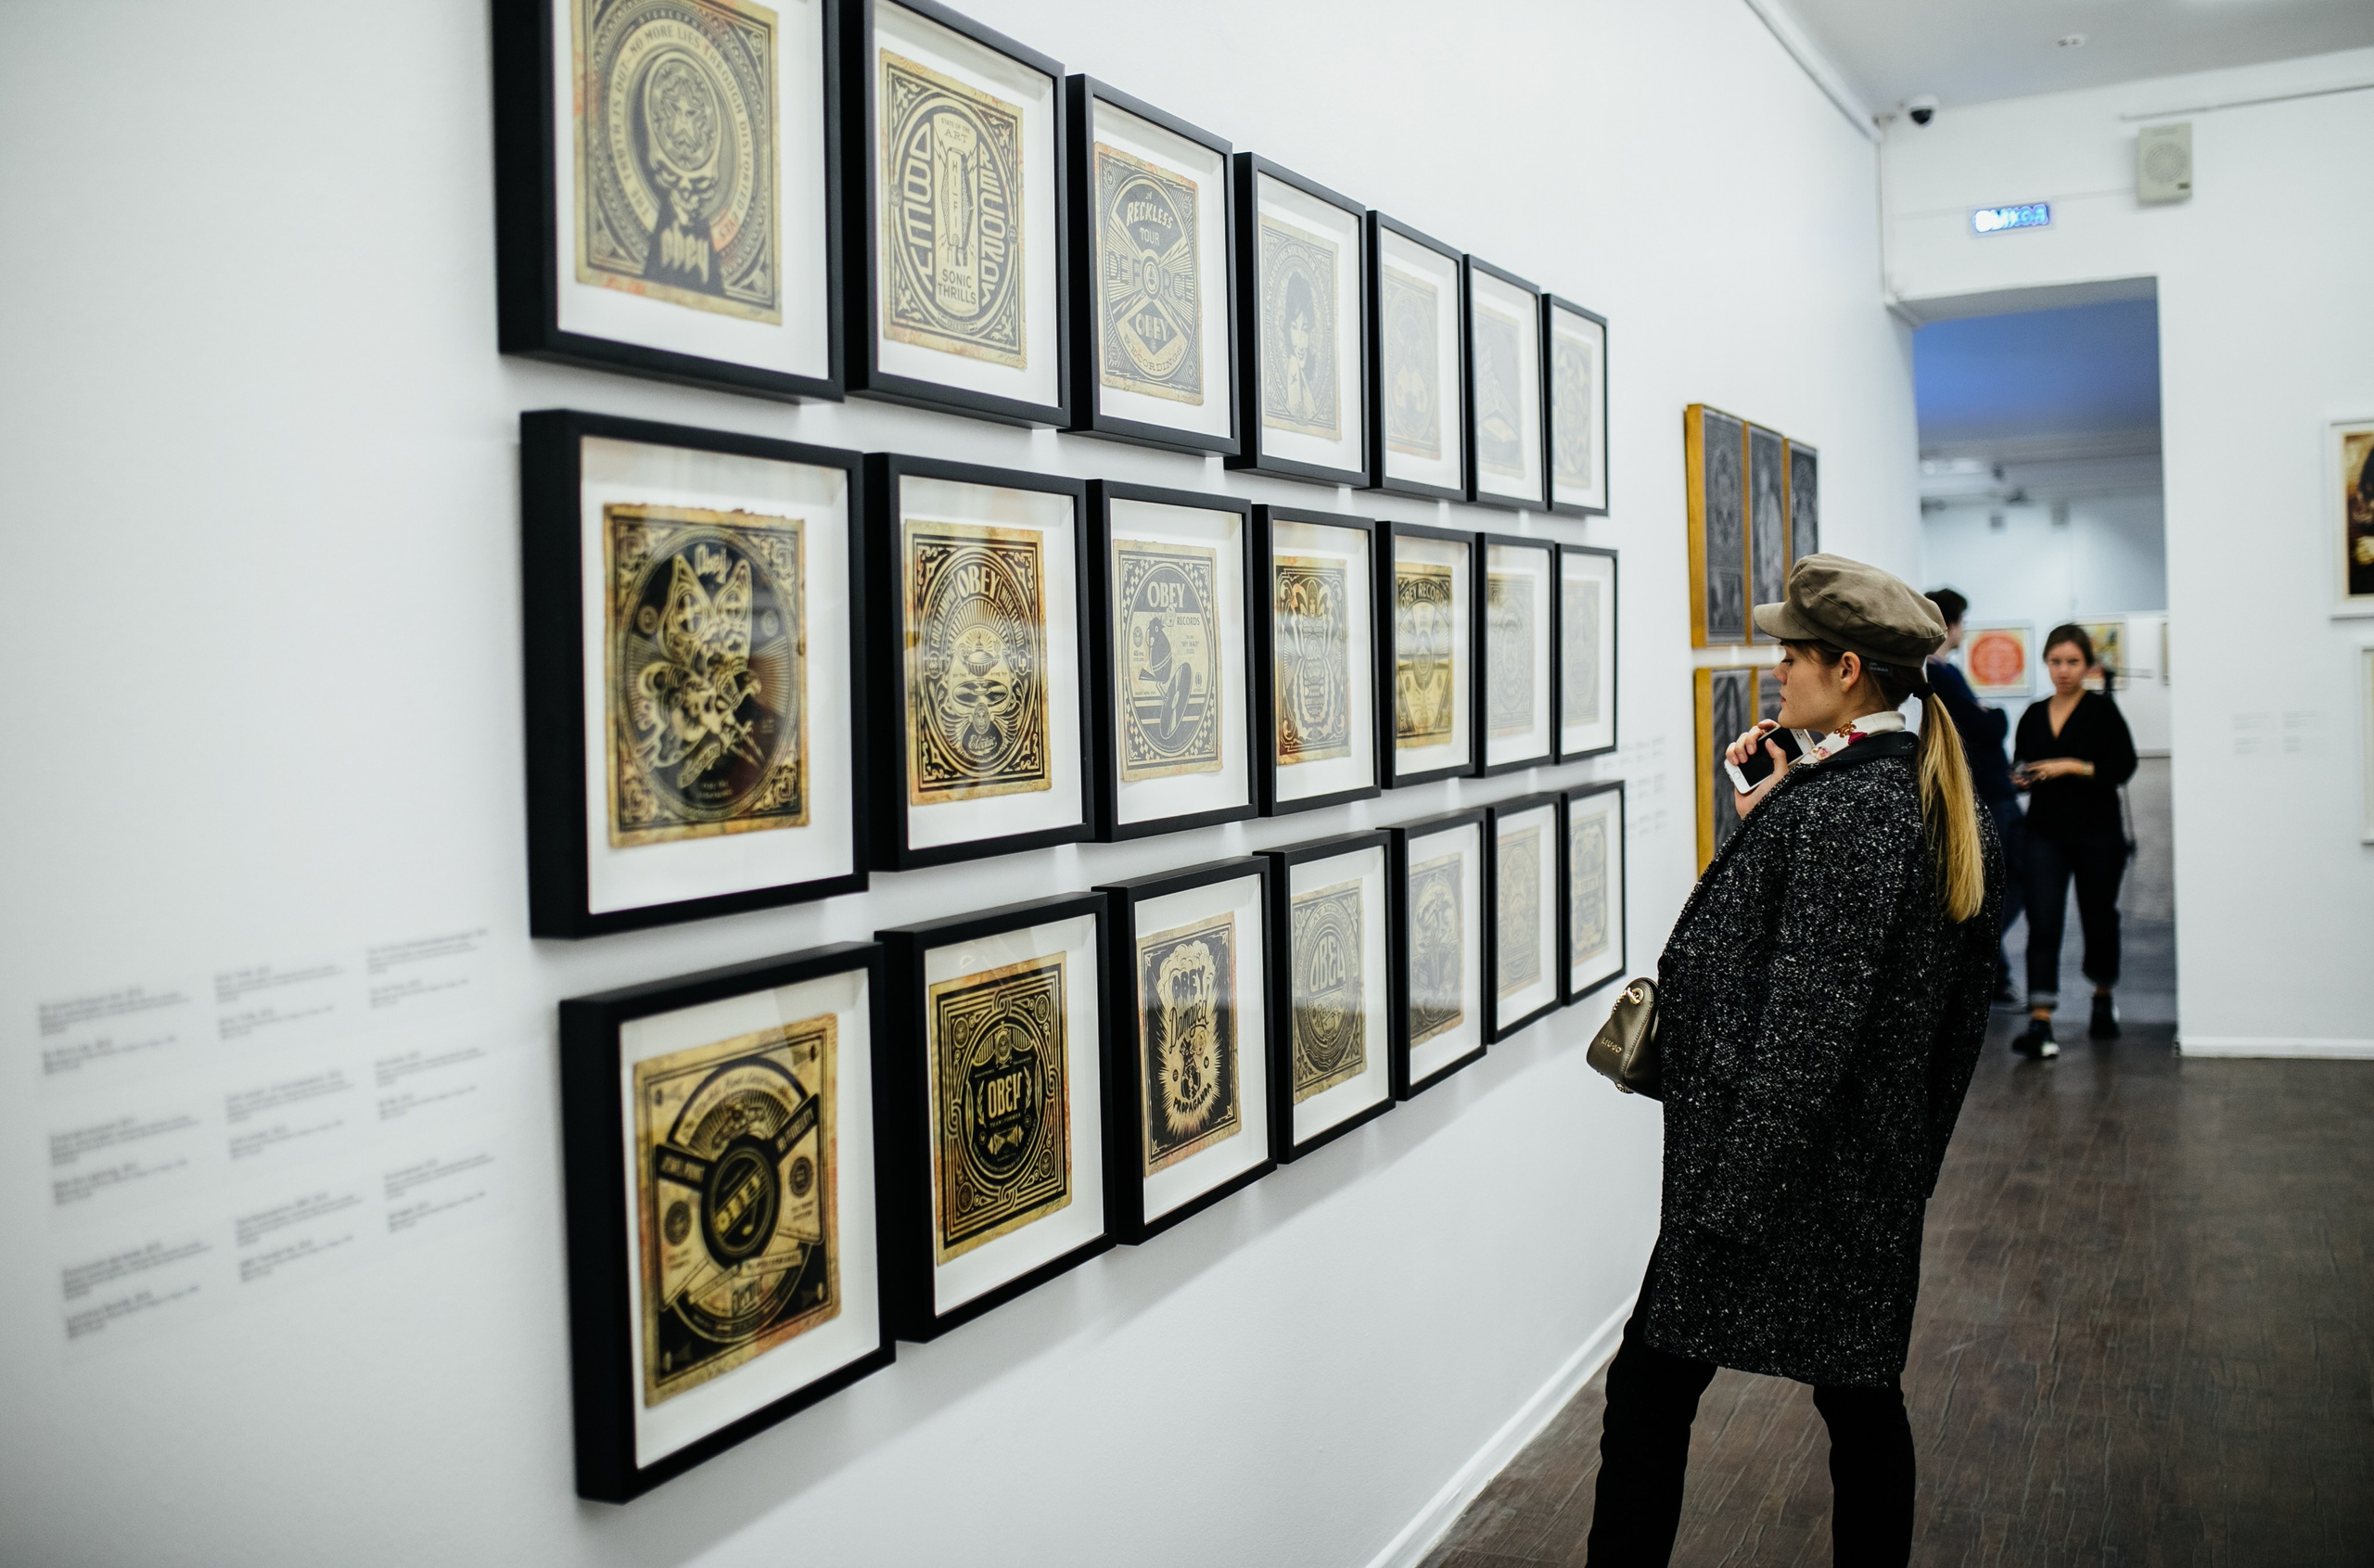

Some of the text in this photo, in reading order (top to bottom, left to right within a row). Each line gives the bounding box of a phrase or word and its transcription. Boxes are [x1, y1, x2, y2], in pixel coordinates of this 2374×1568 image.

[615, 63, 630, 92] OUT
[630, 36, 645, 55] NO
[645, 24, 674, 41] MORE
[677, 26, 700, 47] LIES
[703, 45, 744, 114] THROUGH
[736, 122, 752, 210] DISTORTED
[941, 117, 955, 127] STATE
[944, 129, 968, 144] ART
[1126, 200, 1174, 229] RECKLESS
[1140, 226, 1160, 246] TOUR
[942, 268, 972, 288] SONIC
[938, 282, 976, 305] THRILLS
[1135, 312, 1169, 341] OBEY
[1124, 334, 1182, 372] RECORDINGS
[957, 565, 1001, 600] OBEY
[1147, 580, 1185, 608] OBEY
[1000, 586, 1015, 611] WITH
[1401, 582, 1449, 614] OBEY RECORDS
[931, 618, 944, 648] COLD
[1176, 617, 1200, 625] RECORDS
[1309, 935, 1347, 993] OBEY
[1172, 965, 1206, 1000] OBEY
[1168, 984, 1209, 1055] Damaged
[988, 1071, 1023, 1119] OBEY
[1173, 1083, 1213, 1113] PROPAGANDA
